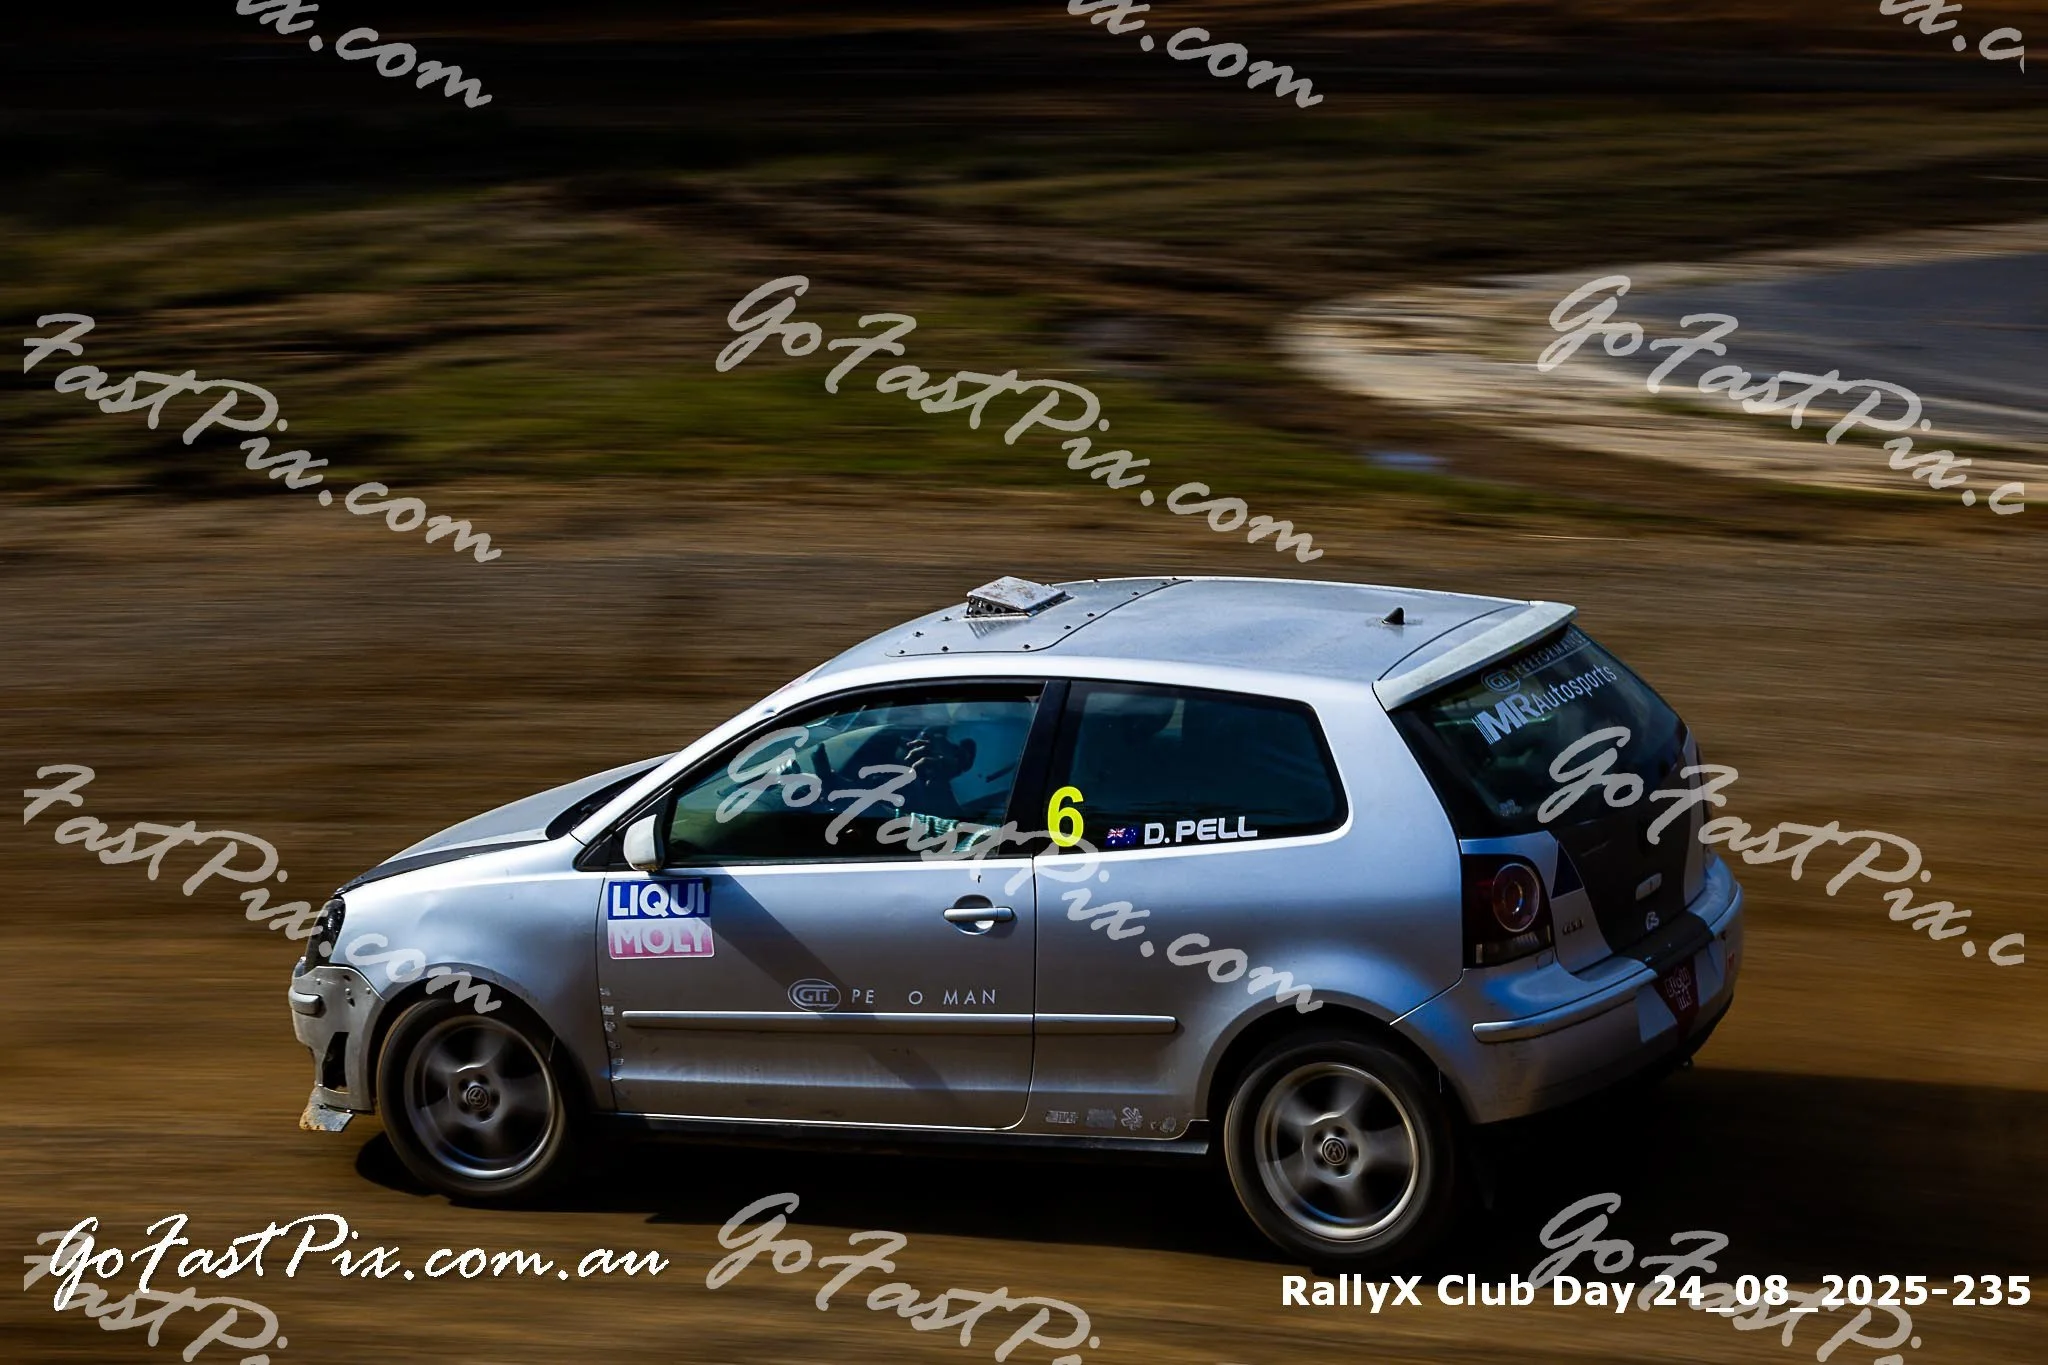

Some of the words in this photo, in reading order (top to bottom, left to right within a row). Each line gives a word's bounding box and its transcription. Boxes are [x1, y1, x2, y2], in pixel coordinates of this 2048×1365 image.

[1047, 786, 1084, 847] 6
[612, 883, 705, 918] LIQUI
[611, 923, 706, 955] MOLY
